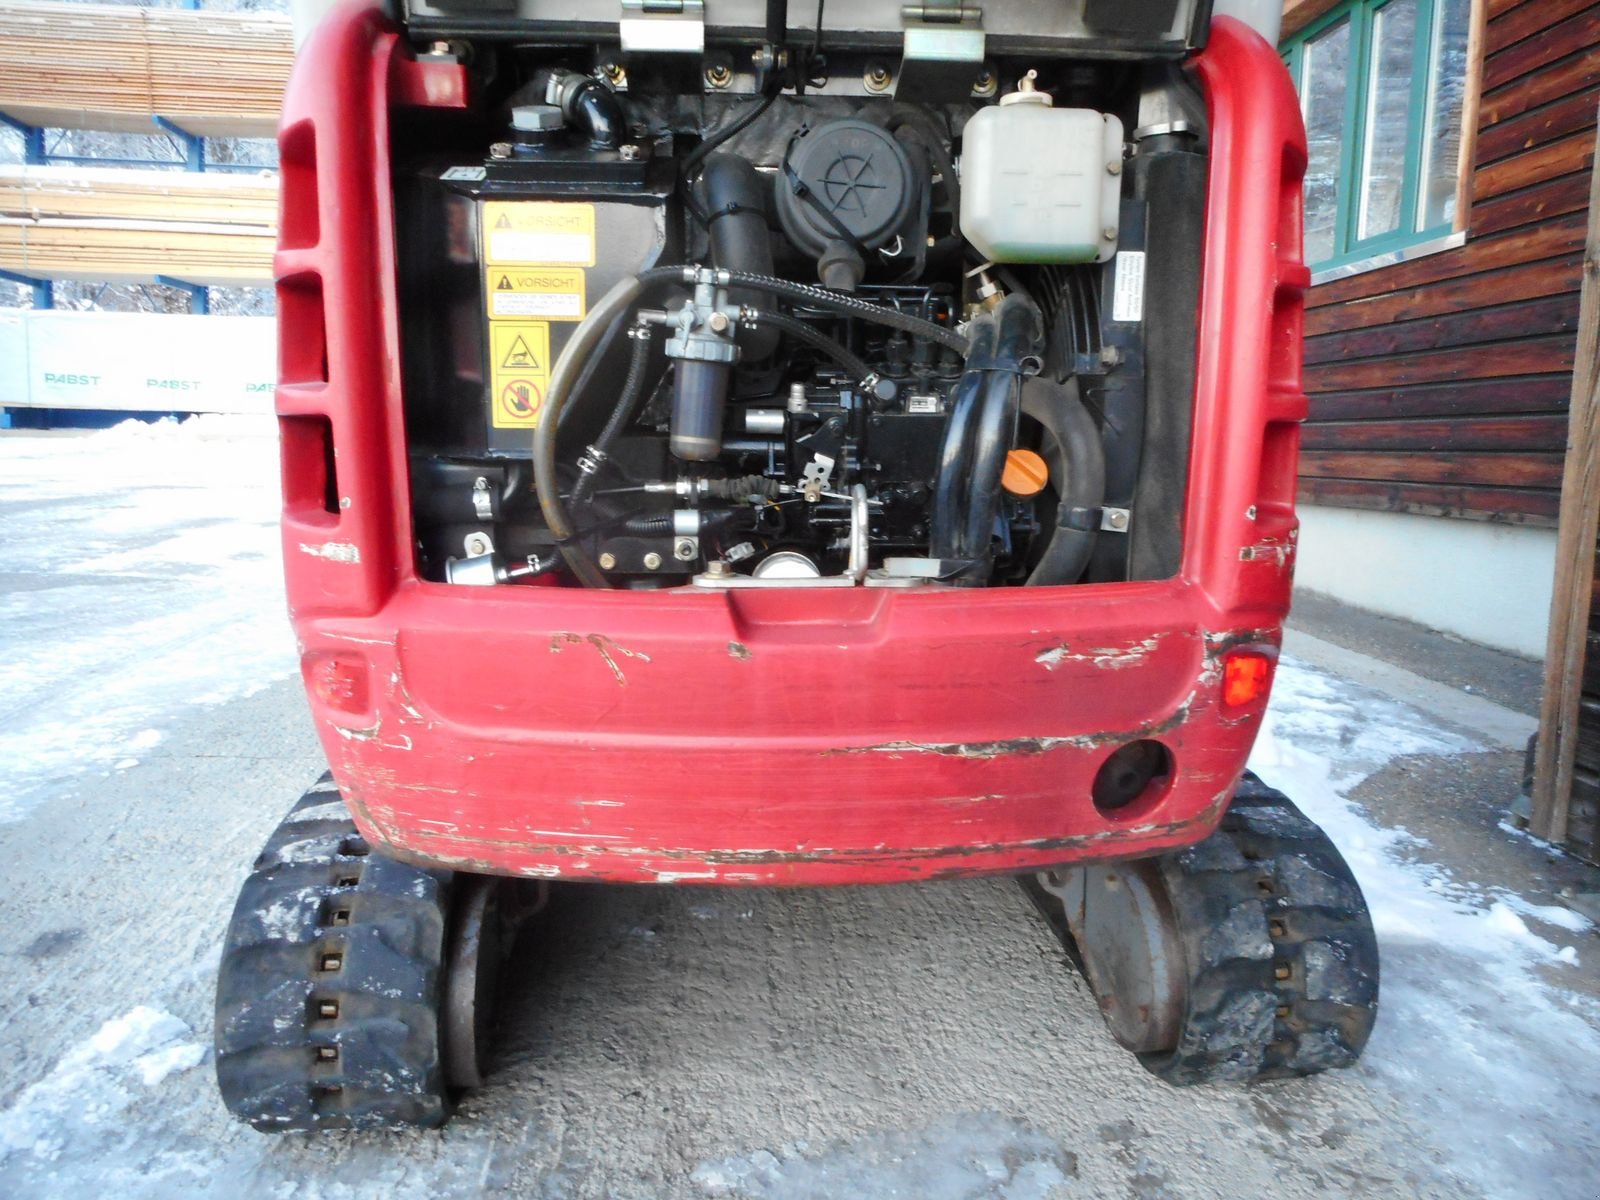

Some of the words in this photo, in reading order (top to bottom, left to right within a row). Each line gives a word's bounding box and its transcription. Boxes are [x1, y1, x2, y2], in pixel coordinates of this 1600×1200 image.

[516, 277, 575, 288] VORSICHT
[45, 373, 101, 386] PABST
[147, 378, 201, 391] PABST
